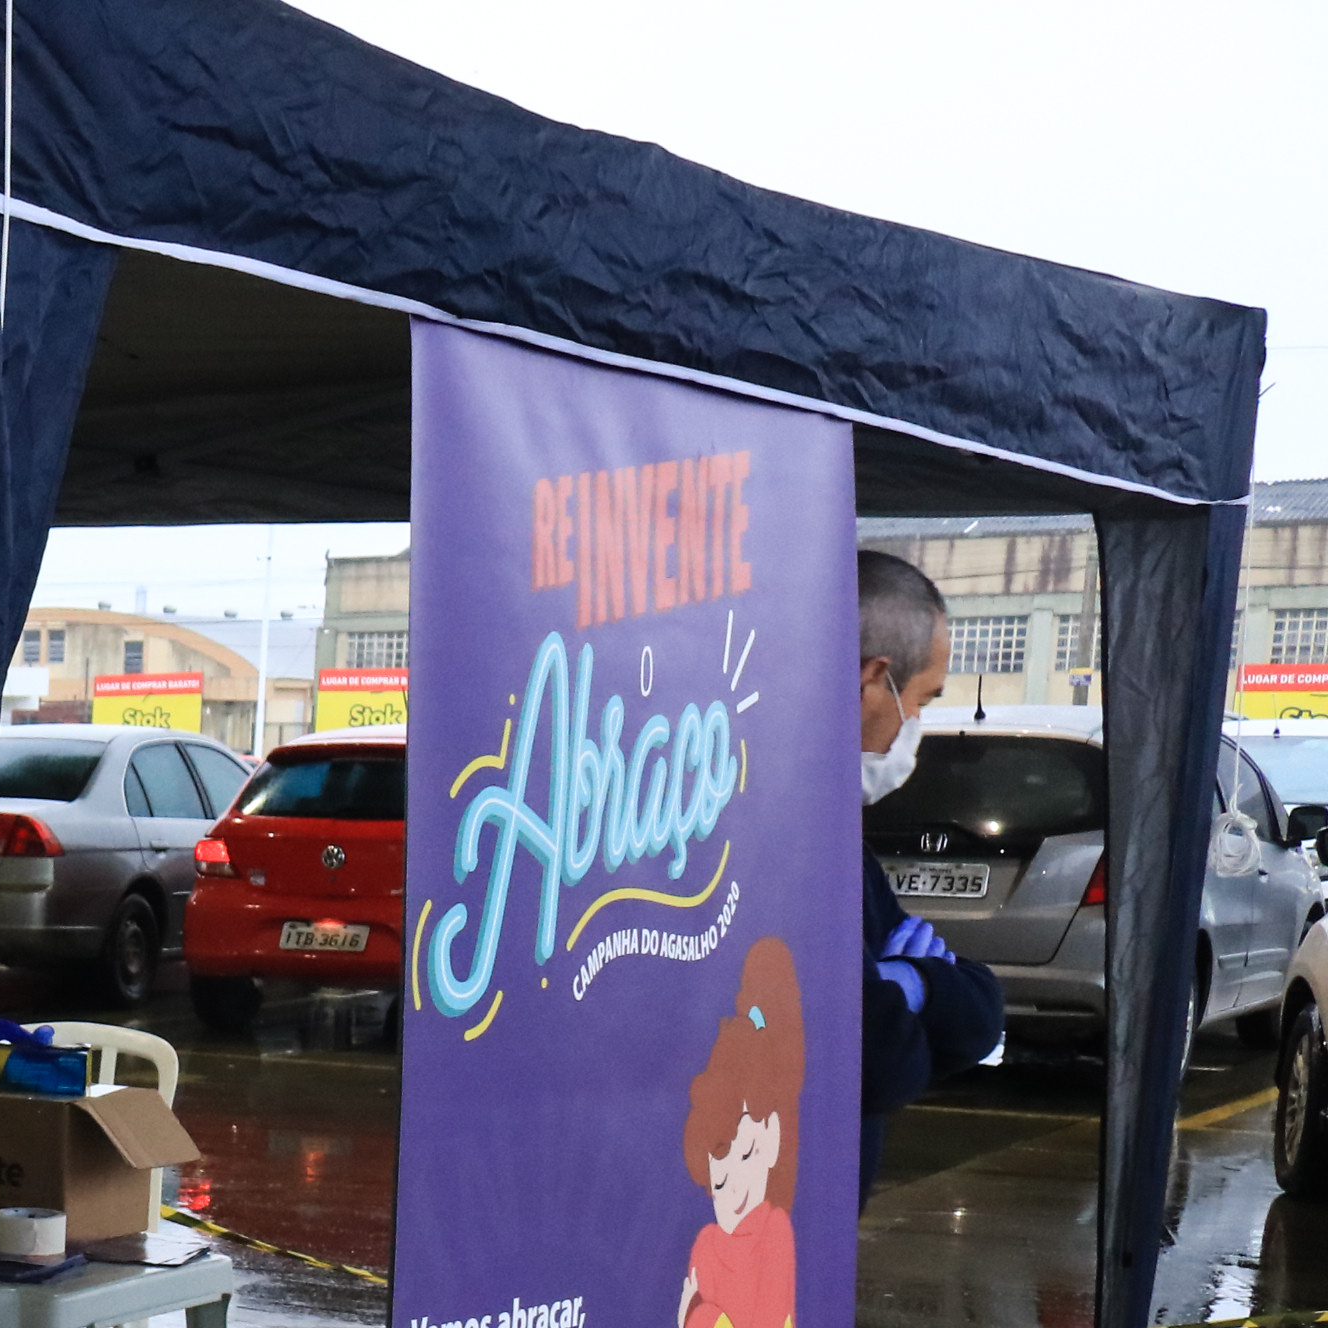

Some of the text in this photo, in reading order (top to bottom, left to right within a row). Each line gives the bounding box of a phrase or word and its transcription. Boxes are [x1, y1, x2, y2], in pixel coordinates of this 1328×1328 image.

[530, 449, 752, 631] REINVENTE
[96, 680, 200, 691] LUGAR DE COMPRAR BARATO!
[321, 676, 348, 686] LUGAR
[348, 676, 360, 686] DE
[360, 676, 400, 686] COMPRAR
[1242, 673, 1278, 684] LUGAR
[1280, 673, 1295, 684] DE
[122, 706, 171, 728] Stok
[348, 703, 403, 727] Stok
[427, 631, 739, 1018] Abraço
[572, 881, 740, 1001] CAMPANHA DO AGASALHO 2020
